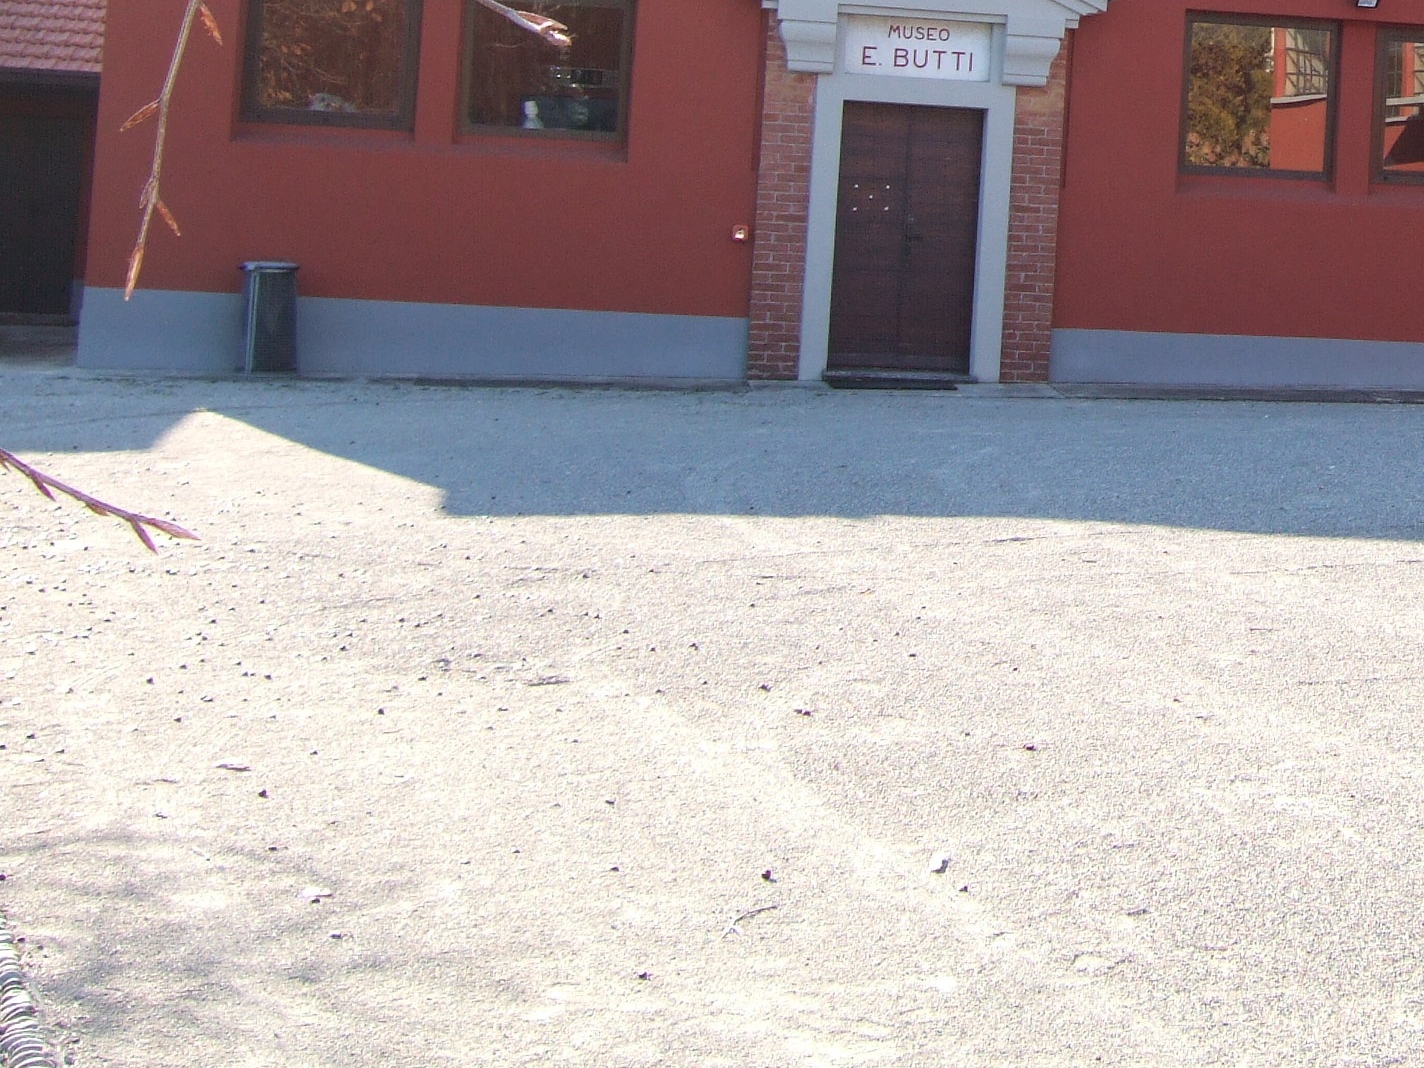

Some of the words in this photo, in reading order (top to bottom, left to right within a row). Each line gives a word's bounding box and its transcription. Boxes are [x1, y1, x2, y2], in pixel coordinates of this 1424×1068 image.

[888, 24, 950, 42] MUSEO
[862, 46, 882, 66] E.
[893, 48, 973, 72] BUTTI
